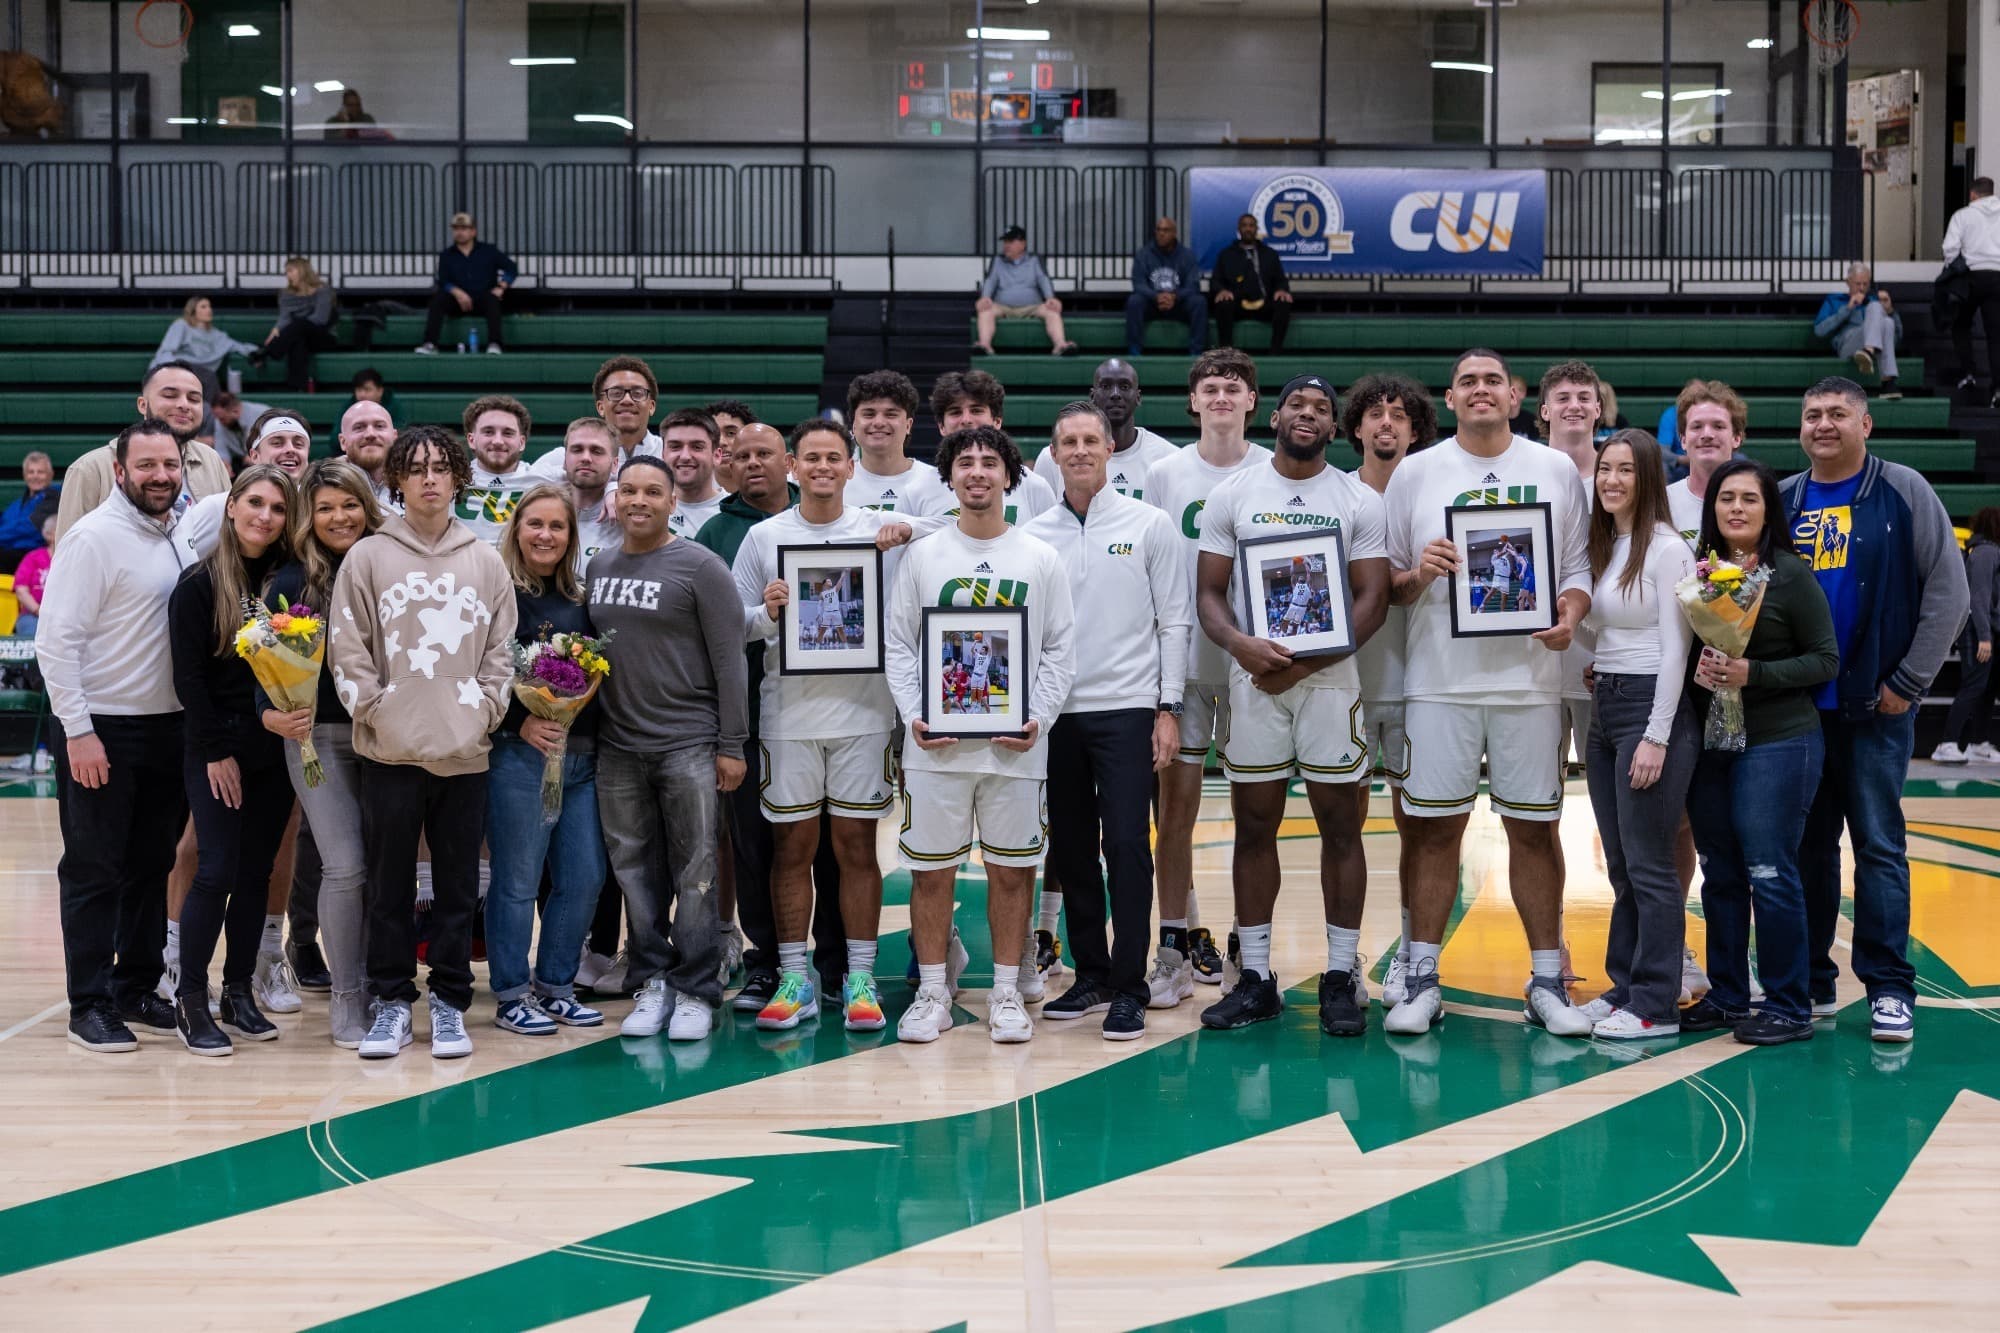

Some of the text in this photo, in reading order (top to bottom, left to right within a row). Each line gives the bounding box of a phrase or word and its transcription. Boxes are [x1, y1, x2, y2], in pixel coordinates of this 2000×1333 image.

[1271, 202, 1320, 238] 50
[1390, 191, 1520, 253] CUI
[454, 487, 523, 523] CU
[1251, 512, 1341, 530] CONCORDIA
[1107, 543, 1133, 555] CUI
[589, 576, 663, 611] NIKE
